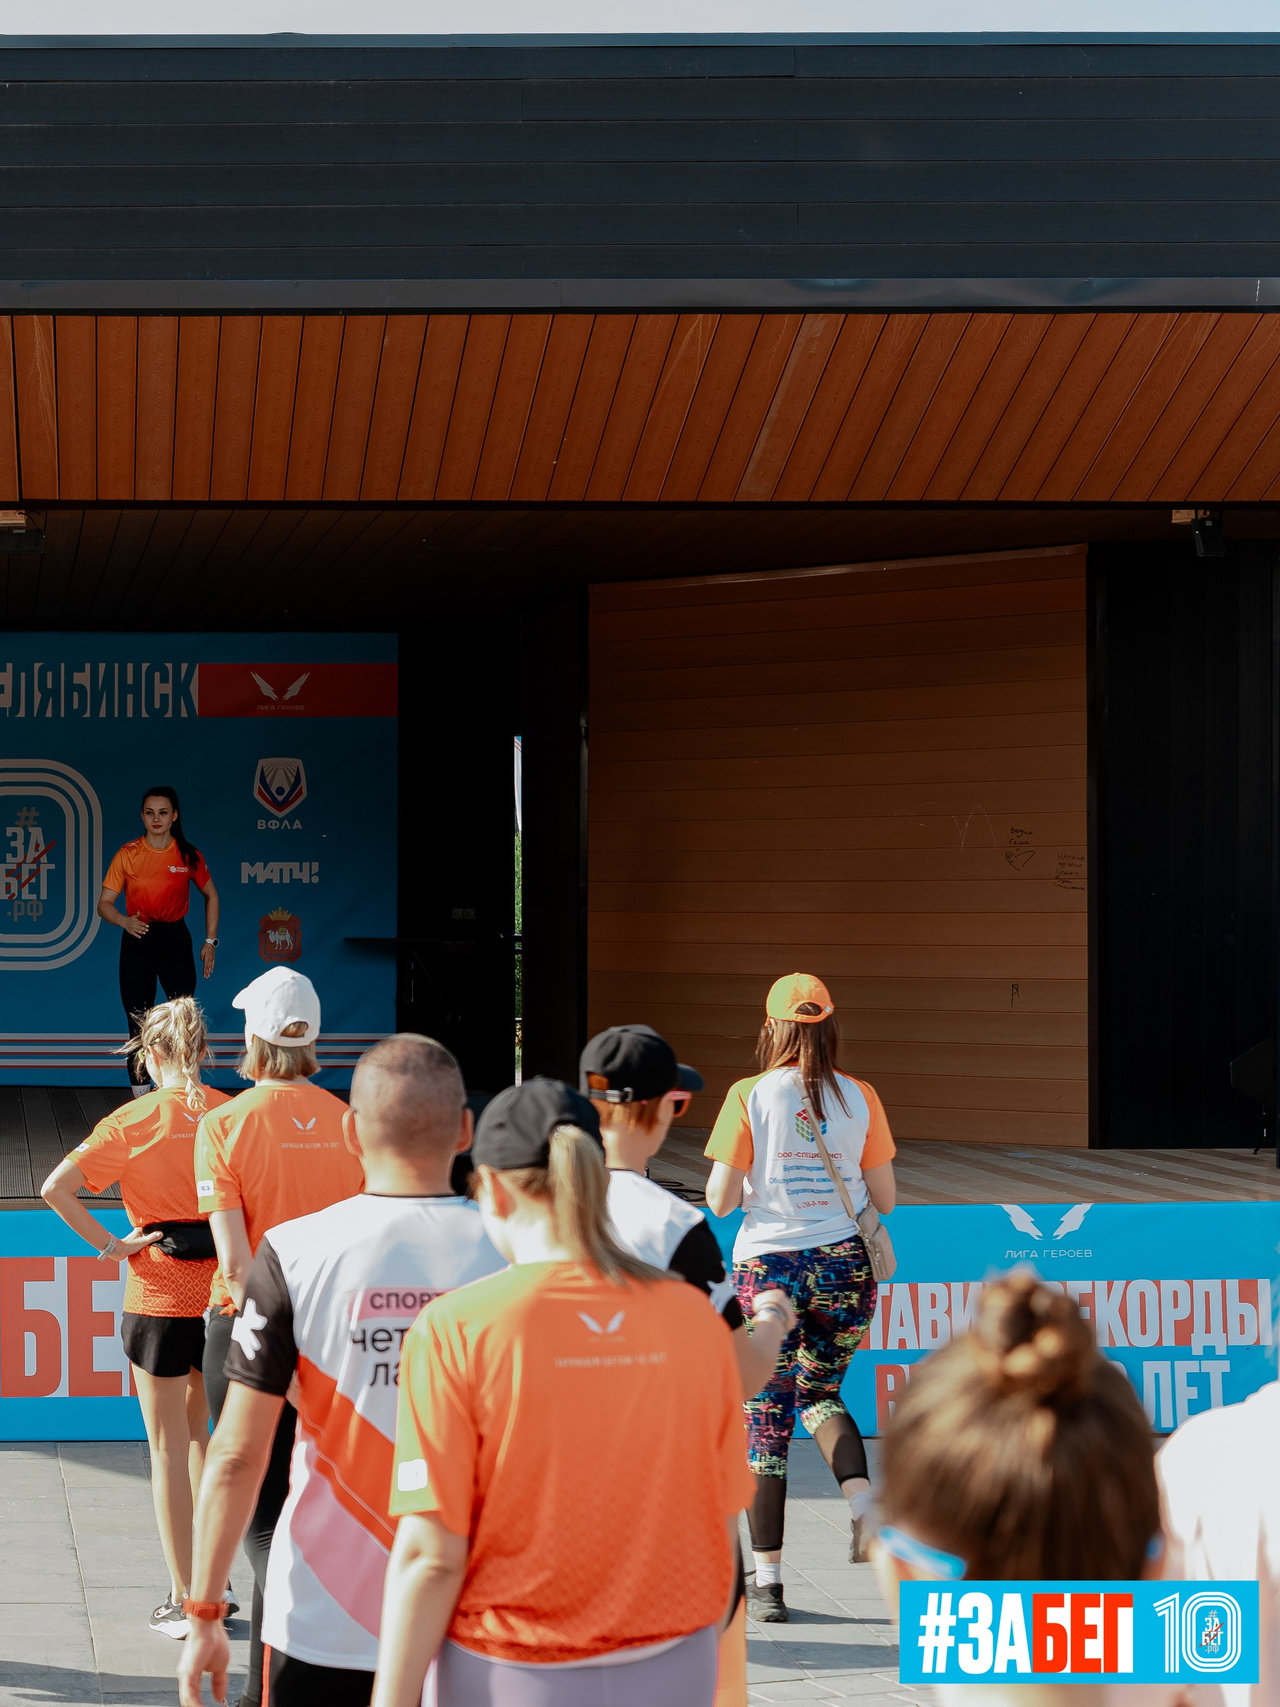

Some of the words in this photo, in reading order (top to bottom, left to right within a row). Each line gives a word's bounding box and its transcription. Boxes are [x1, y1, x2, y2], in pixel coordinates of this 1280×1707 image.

[241, 861, 319, 884] МАТЧ!
[1004, 1248, 1038, 1258] ЛИГА
[1043, 1248, 1093, 1258] ГЕРОЕВ
[1142, 1360, 1231, 1429] ЛЕТ
